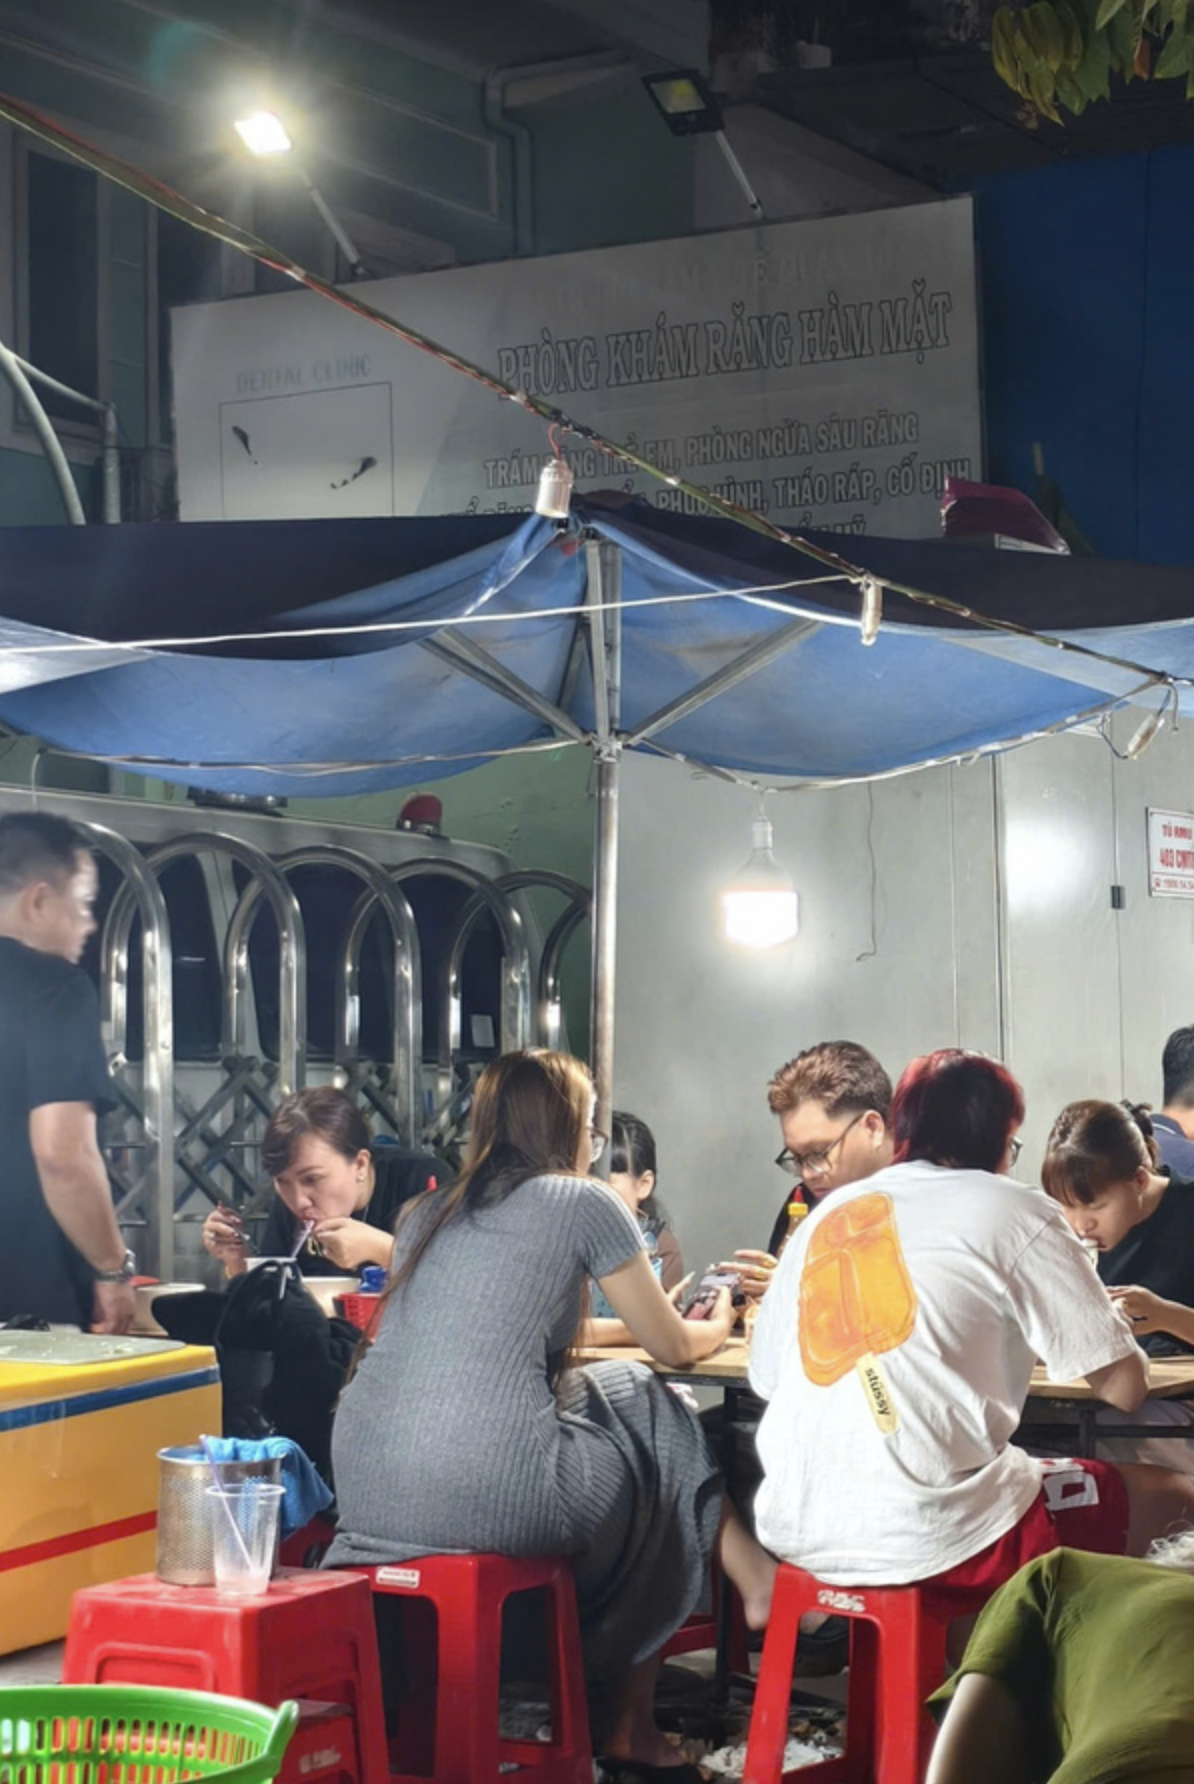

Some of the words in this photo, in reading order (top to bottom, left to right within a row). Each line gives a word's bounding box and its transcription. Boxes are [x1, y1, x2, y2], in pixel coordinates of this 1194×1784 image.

[498, 327, 600, 398] PHÒNG
[606, 311, 699, 388] KHÁM
[704, 301, 794, 375] RĂNG
[799, 290, 875, 365] HÀM
[879, 278, 953, 364] MẶT
[484, 449, 538, 489] TRÁM
[686, 425, 753, 467] PHÒNG
[757, 417, 811, 461] NGỪA
[816, 412, 857, 450] SÂU
[861, 410, 919, 447] RĂNG
[772, 466, 829, 508] THÁO
[886, 452, 919, 496] CỐ
